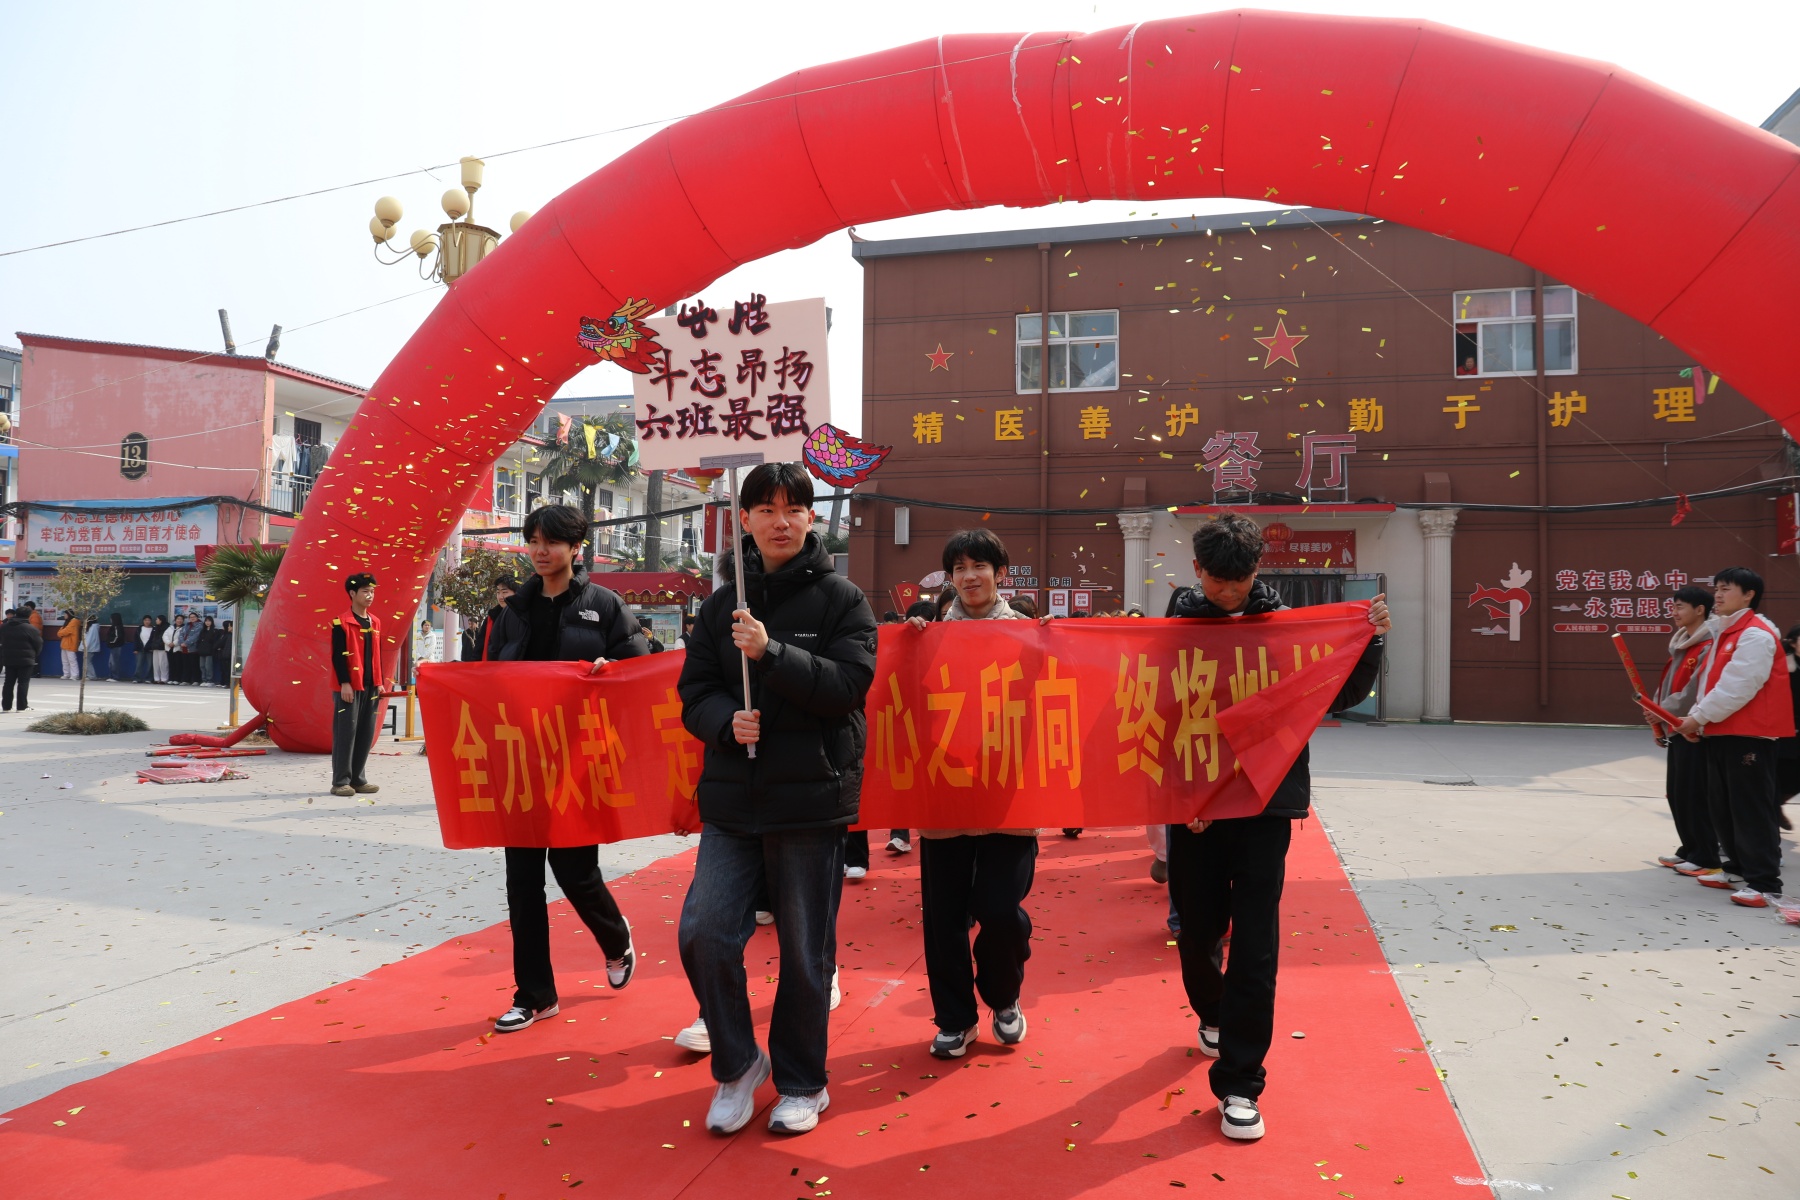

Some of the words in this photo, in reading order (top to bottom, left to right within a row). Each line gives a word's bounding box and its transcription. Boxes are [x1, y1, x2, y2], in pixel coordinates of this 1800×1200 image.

[649, 346, 814, 401] 斗志昂扬
[635, 393, 810, 441] 六班最强
[912, 403, 1199, 444] 精医善护
[1348, 386, 1697, 434] 勤于护理
[1201, 430, 1357, 492] 餐厅
[40, 526, 116, 543] 牢记为党育人
[122, 524, 202, 541] 为国育才使命
[59, 510, 181, 525] 不忘立德树人初心
[1289, 542, 1333, 553] 尽释美妙
[1556, 569, 1688, 591] 党在我心中
[451, 698, 636, 816] 全力以赴
[875, 656, 1081, 790] 心之所向
[1116, 643, 1334, 787] 终将
